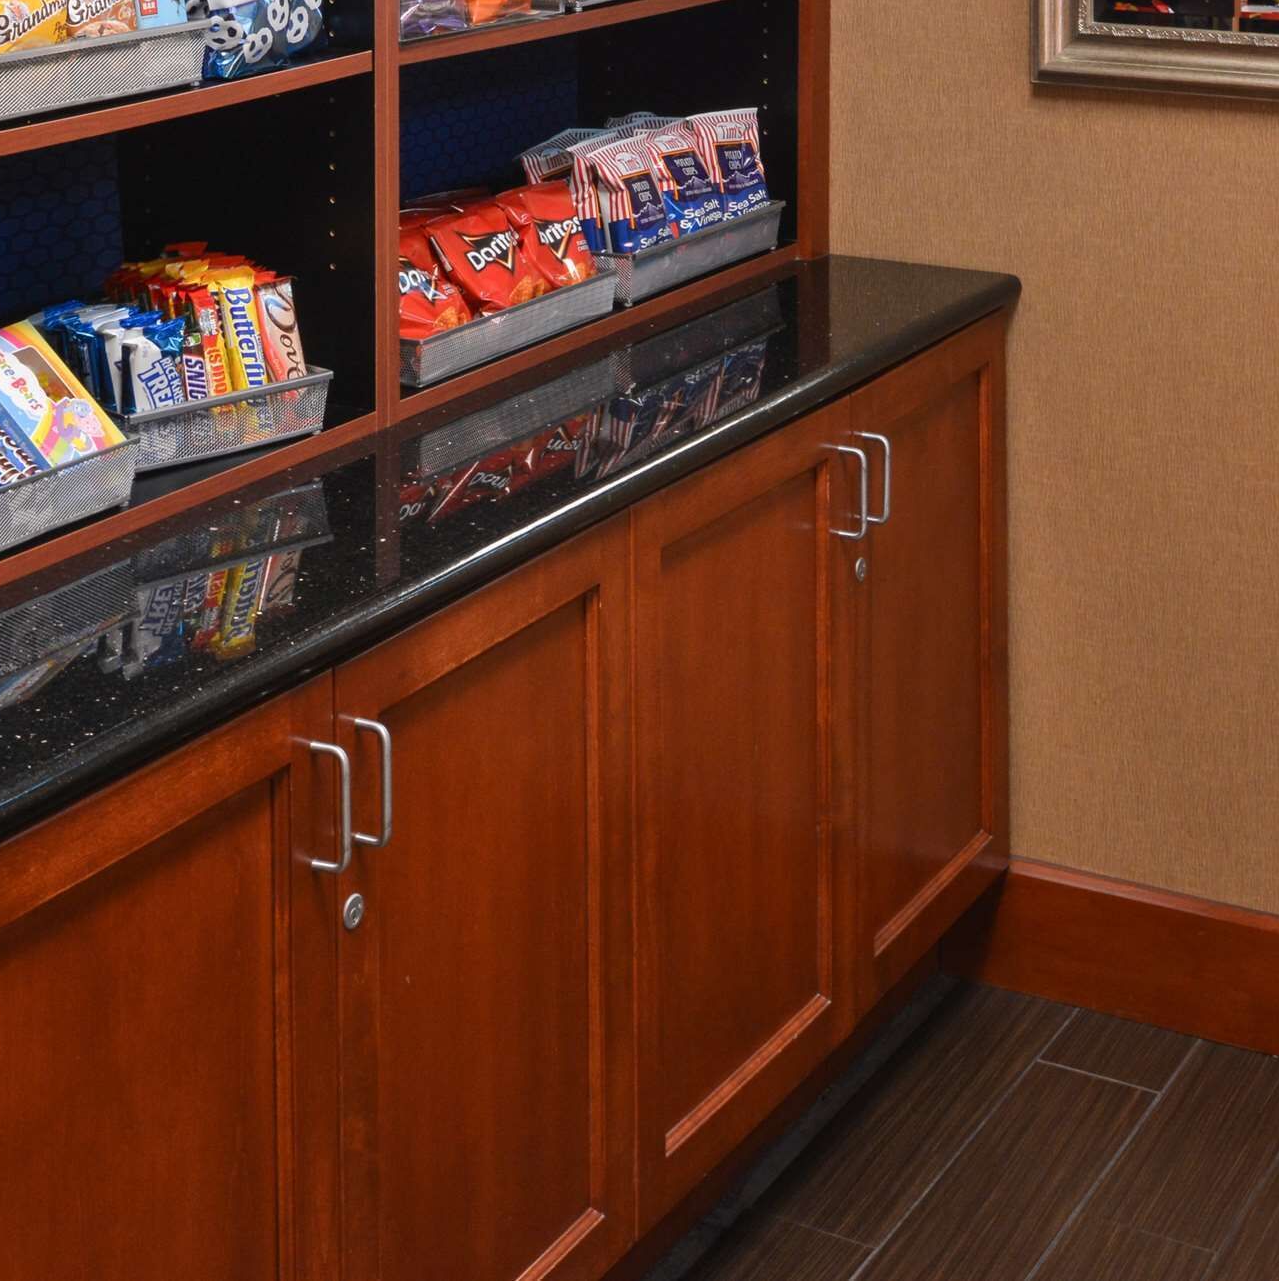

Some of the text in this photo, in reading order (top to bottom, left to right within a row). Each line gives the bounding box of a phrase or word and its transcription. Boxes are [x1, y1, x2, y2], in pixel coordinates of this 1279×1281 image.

[684, 199, 720, 219] Sea Salt
[728, 189, 767, 213] Sea Salt
[264, 283, 307, 380] Dove
[160, 357, 176, 381] RICE
[11, 376, 44, 411] Bears
